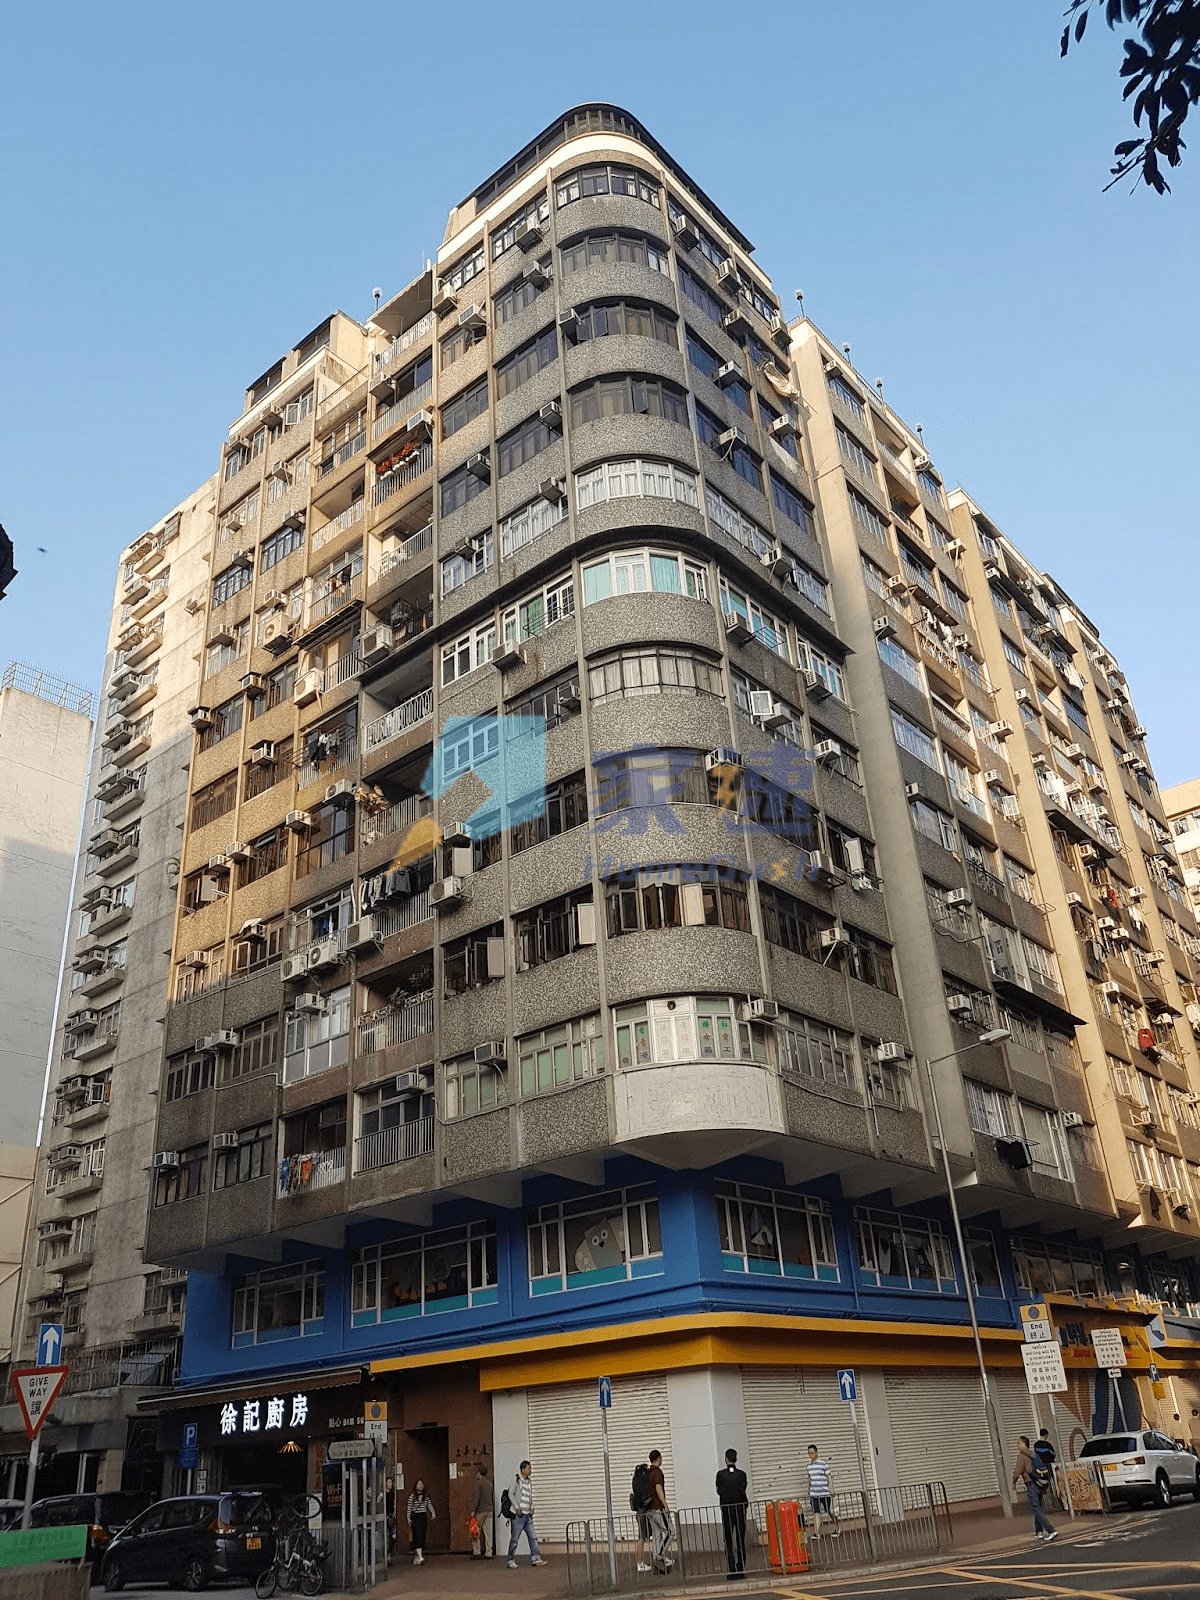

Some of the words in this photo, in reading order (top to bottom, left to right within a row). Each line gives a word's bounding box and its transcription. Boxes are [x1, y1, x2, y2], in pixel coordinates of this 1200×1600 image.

[1029, 1332, 1047, 1340] 終止
[29, 1376, 49, 1387] GIVE
[29, 1387, 48, 1398] WAY
[30, 1400, 42, 1416] 讓
[220, 1393, 309, 1435] 徐記廚房
[186, 1426, 196, 1446] P
